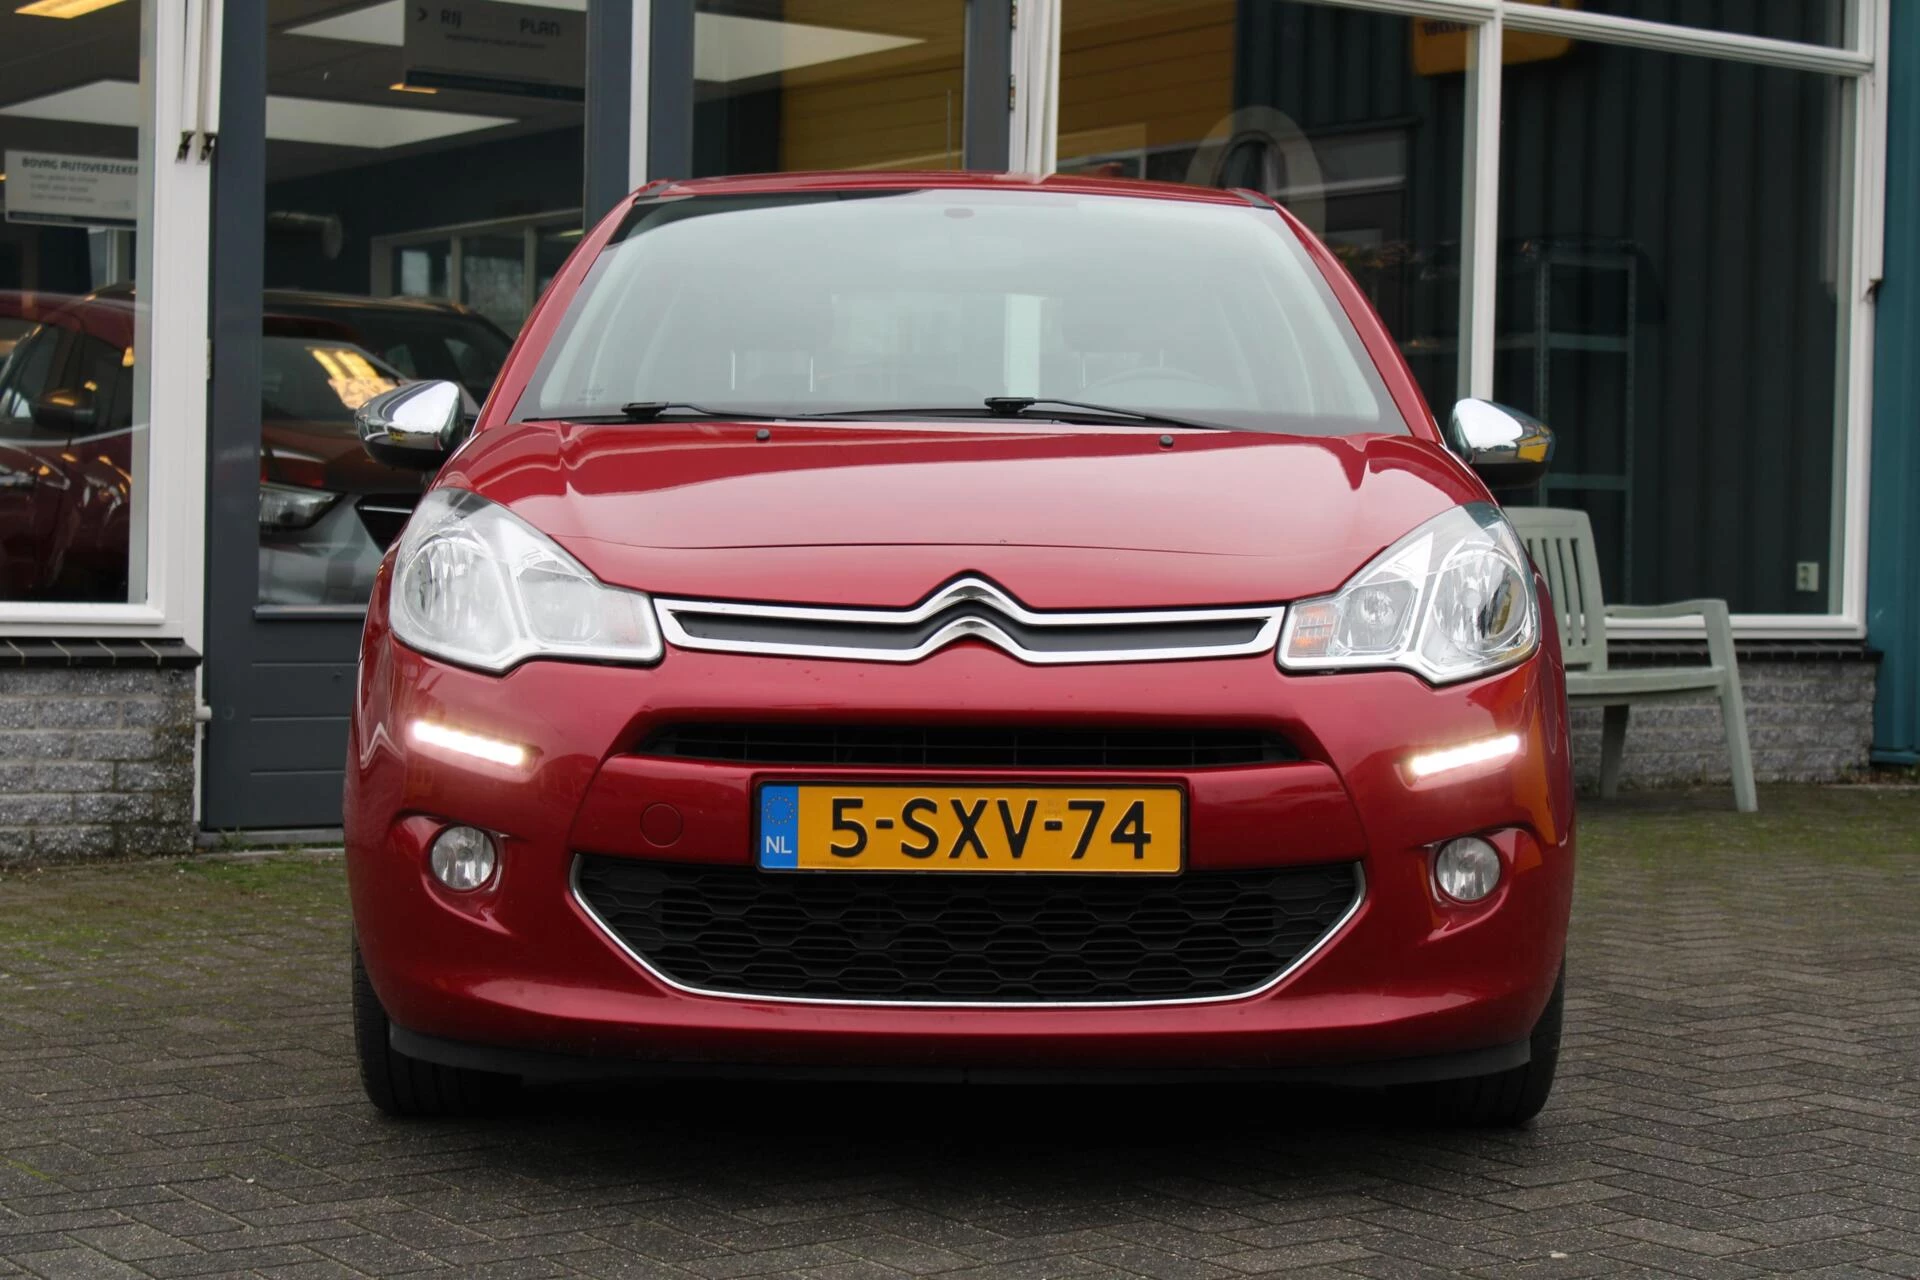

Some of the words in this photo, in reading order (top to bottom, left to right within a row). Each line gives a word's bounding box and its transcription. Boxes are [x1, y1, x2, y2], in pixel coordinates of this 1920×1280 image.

[519, 17, 561, 37] PLAN
[22, 157, 58, 170] BOVAG
[829, 796, 1152, 860] 5-SXV-74
[765, 836, 792, 855] NL
